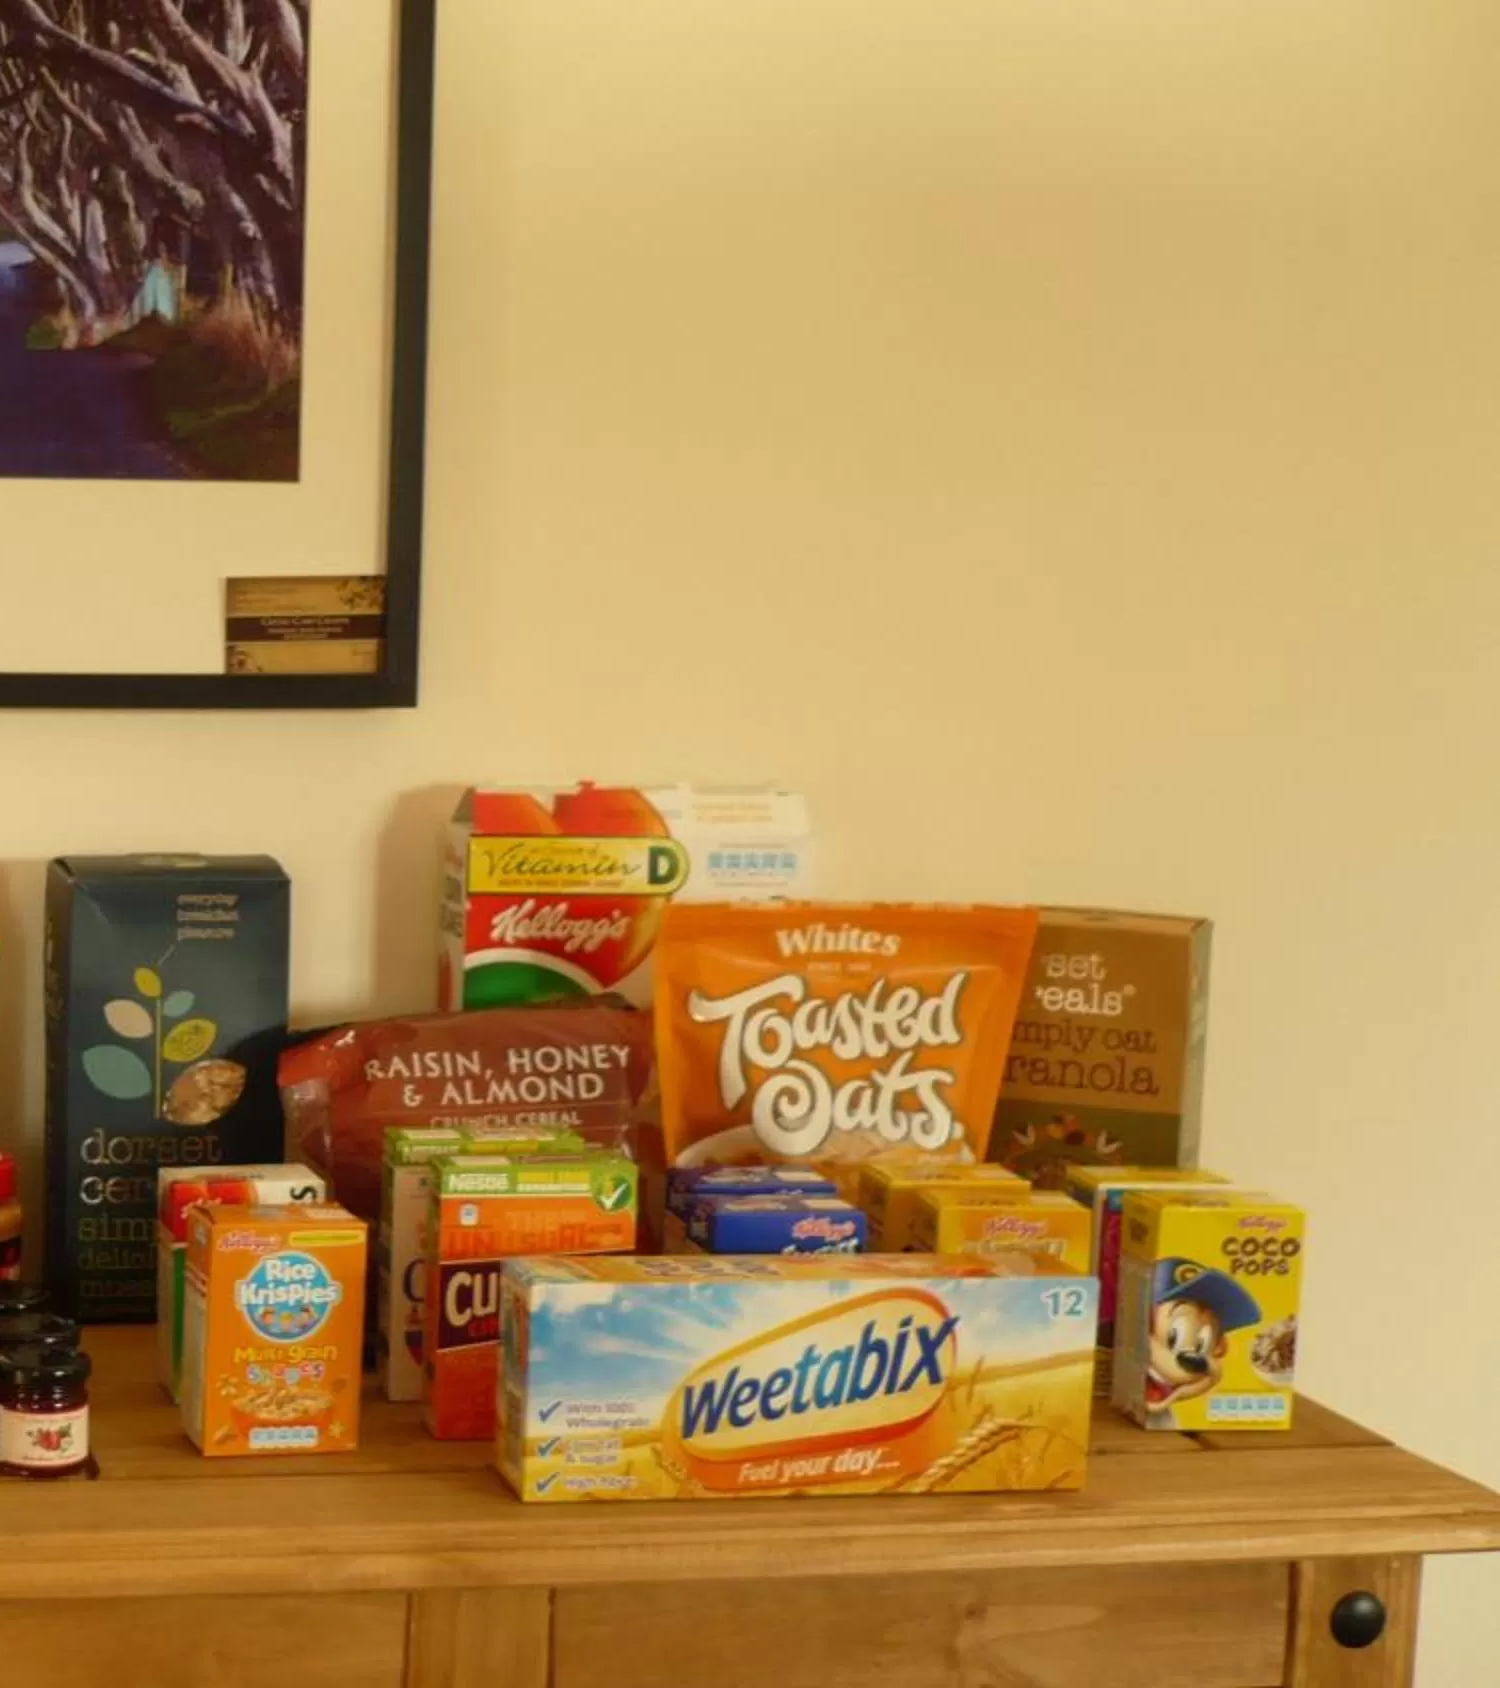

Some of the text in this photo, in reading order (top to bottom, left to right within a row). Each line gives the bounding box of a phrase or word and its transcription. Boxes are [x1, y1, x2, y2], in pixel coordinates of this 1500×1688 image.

[484, 843, 641, 877] Vitamin
[647, 845, 680, 886] D
[489, 898, 632, 953] Kellogg's
[775, 922, 901, 957] Whites
[1041, 953, 1108, 980] set
[1036, 983, 1124, 1016] eals
[688, 971, 968, 1111] Toasted
[365, 1045, 631, 1081] RAISIN, HONEY
[404, 1073, 606, 1107] & ALMOND
[752, 1051, 955, 1156] Oats
[515, 1110, 582, 1126] CEREAL
[80, 1128, 222, 1165] dorset
[1221, 1236, 1301, 1258] COCO
[265, 1258, 316, 1282] Rice
[1230, 1258, 1289, 1277] POPS
[239, 1282, 338, 1307] Krispies
[1046, 1289, 1083, 1316] 12
[681, 1315, 960, 1439] Weetabix
[738, 1460, 780, 1484] Fuel
[780, 1456, 832, 1483] your
